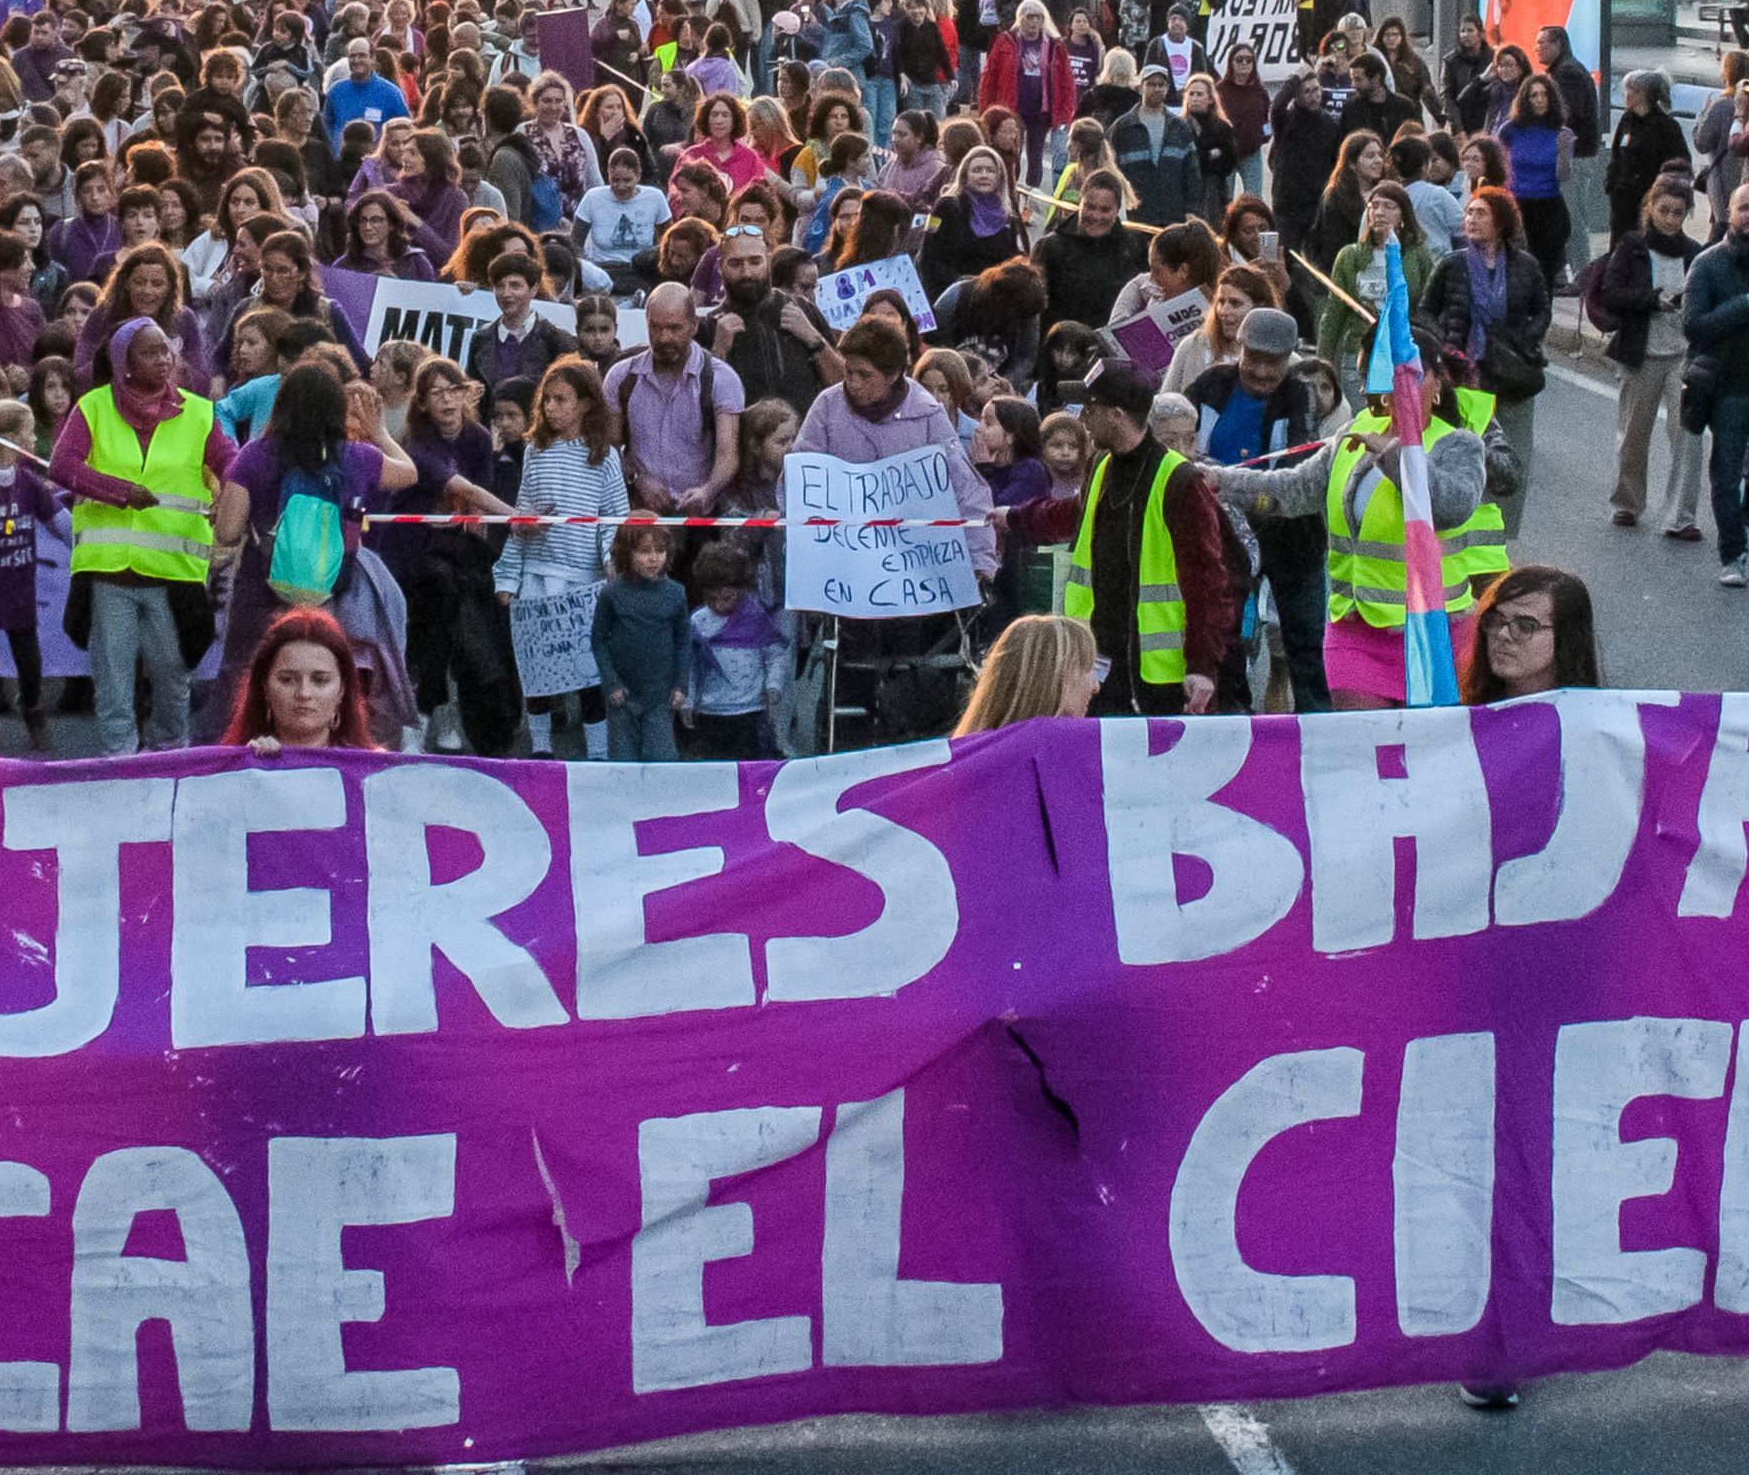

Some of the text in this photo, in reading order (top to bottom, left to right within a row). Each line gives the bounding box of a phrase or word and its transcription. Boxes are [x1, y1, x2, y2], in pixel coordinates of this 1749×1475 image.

[835, 268, 876, 299] 8M
[1167, 304, 1202, 325] NOS
[377, 306, 492, 364] MAT
[801, 452, 950, 514] EL TRABAJO
[808, 515, 914, 551] DECENTE
[824, 577, 954, 606] EN CASA
[632, 1087, 1004, 1395] EL
